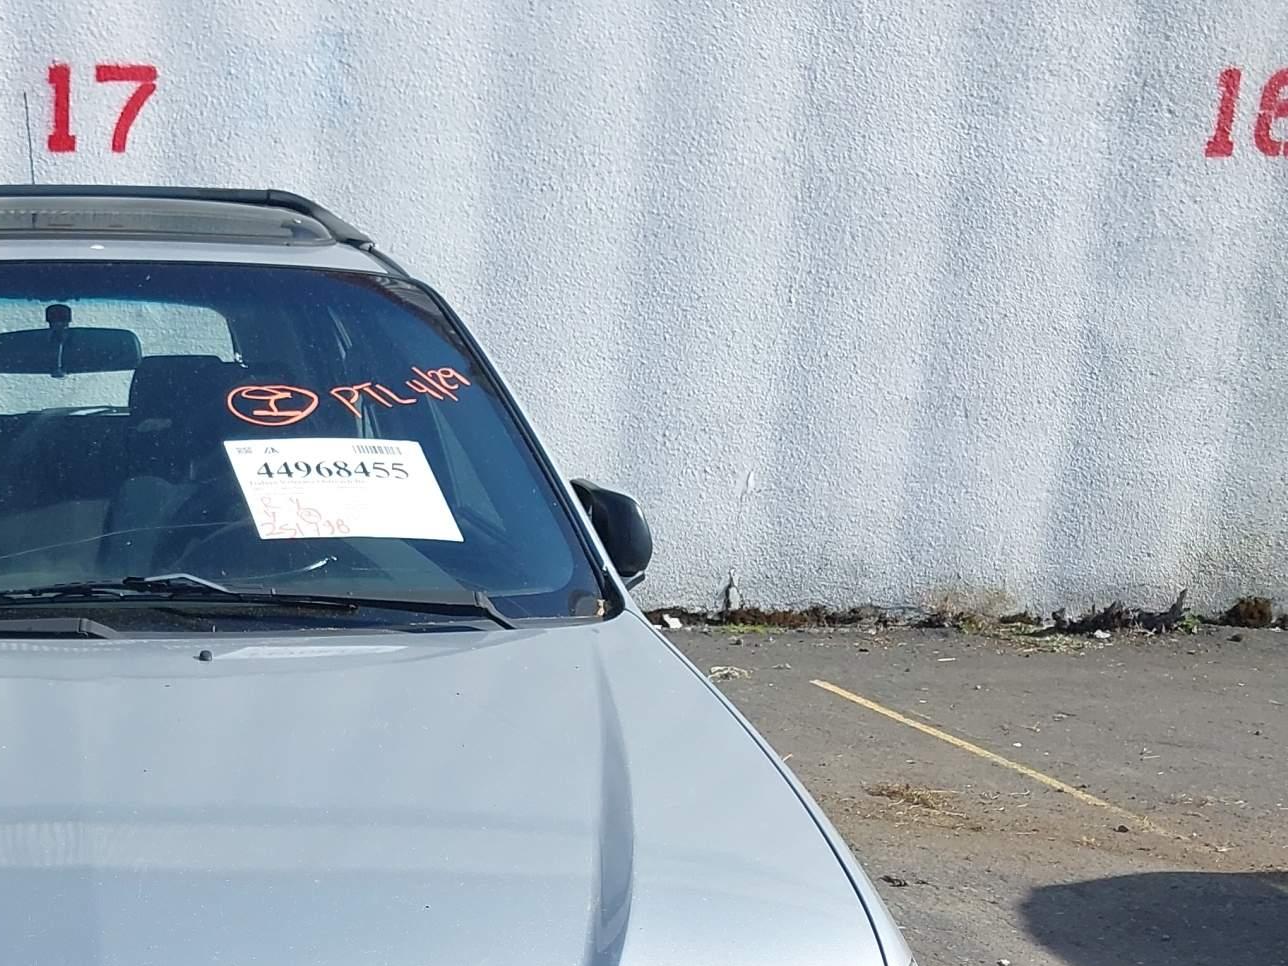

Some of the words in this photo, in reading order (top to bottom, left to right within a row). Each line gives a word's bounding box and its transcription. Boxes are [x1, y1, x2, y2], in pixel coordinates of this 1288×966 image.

[48, 64, 157, 153] 17
[330, 382, 416, 418] PTL
[406, 366, 471, 401] 4/29
[256, 460, 409, 480] 44968455
